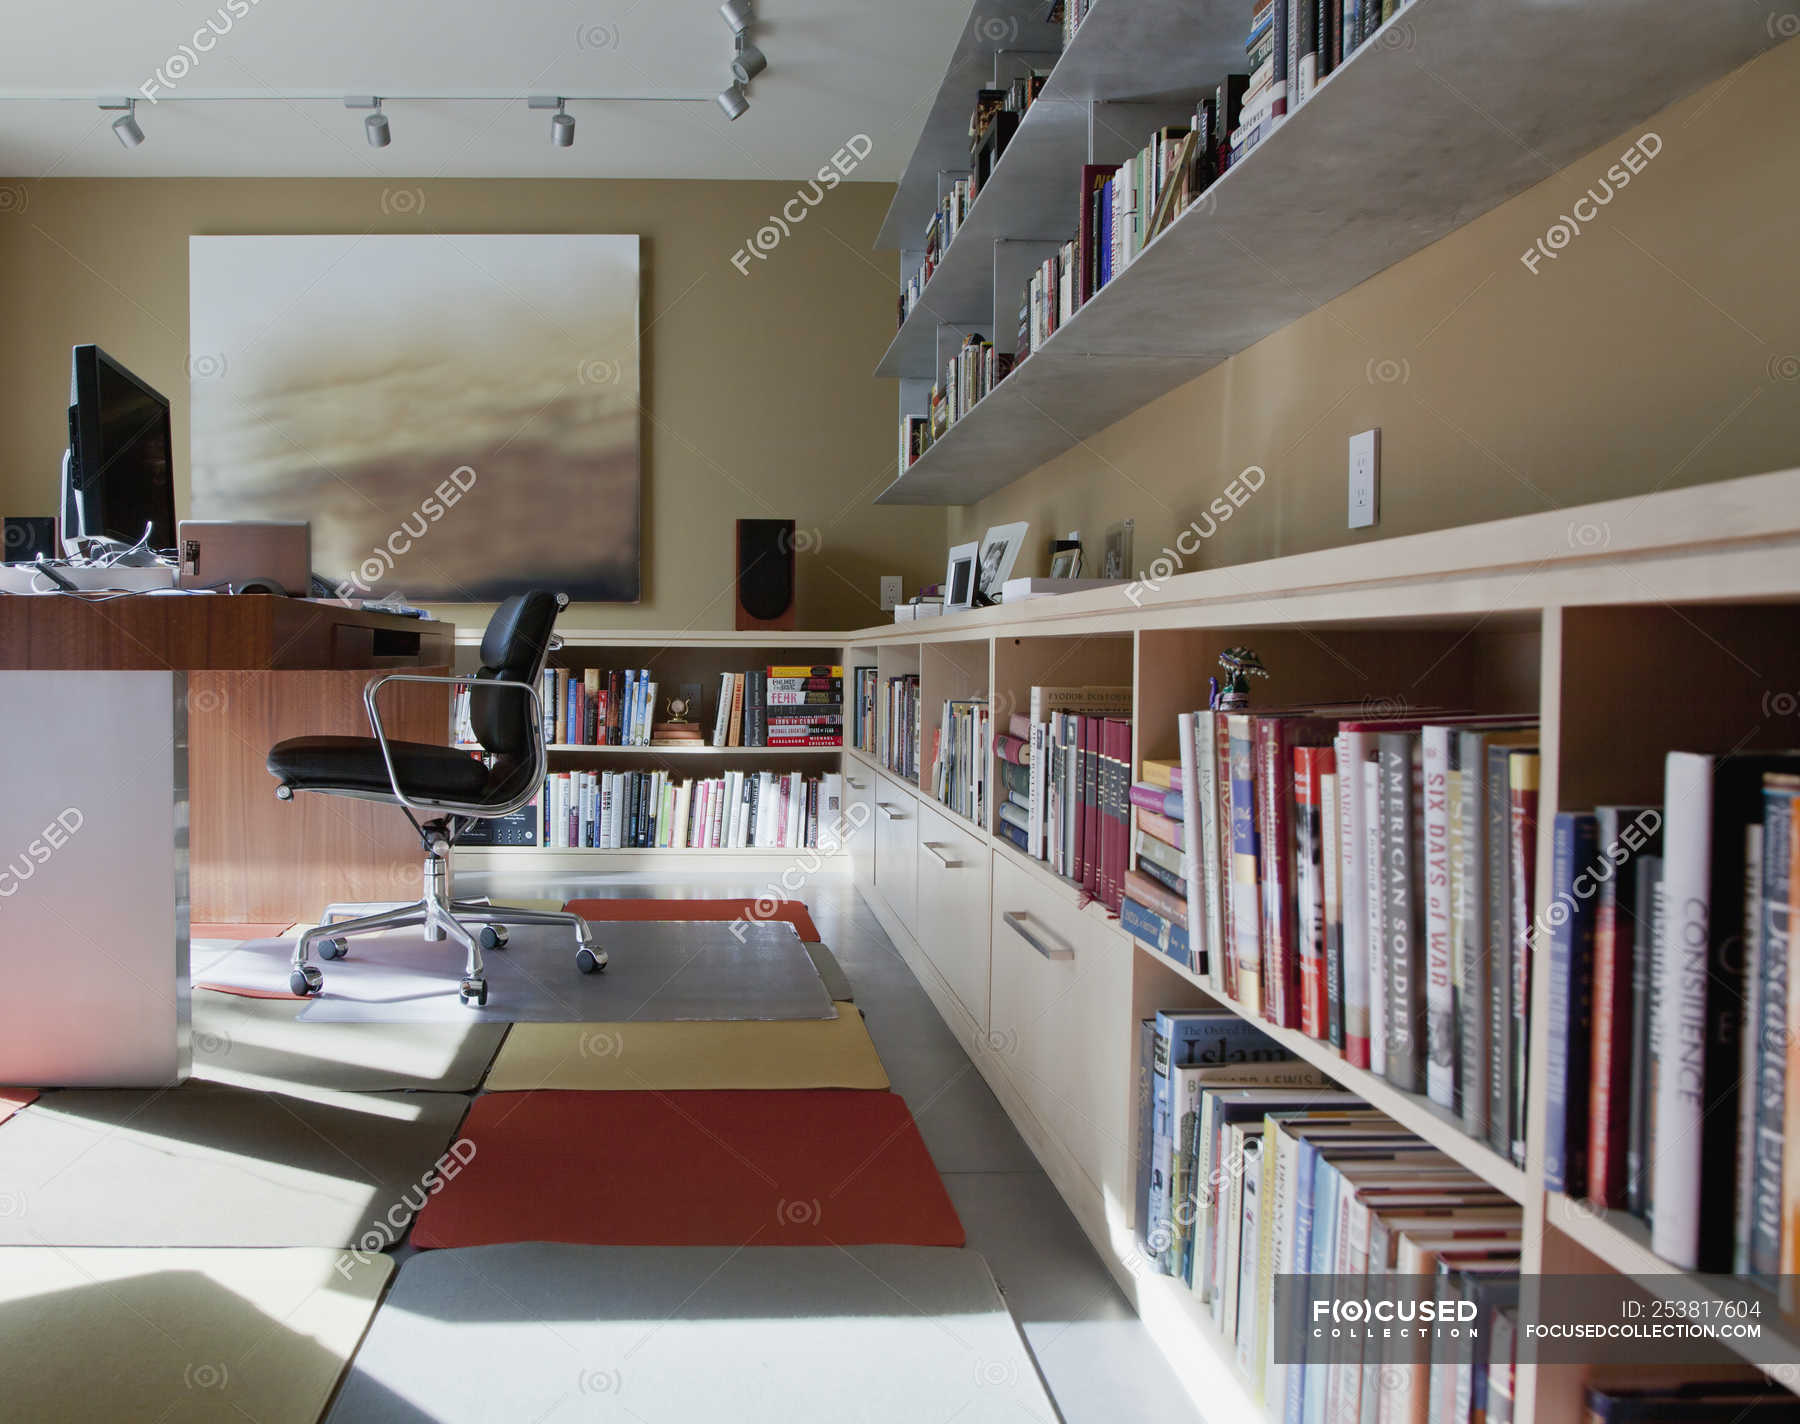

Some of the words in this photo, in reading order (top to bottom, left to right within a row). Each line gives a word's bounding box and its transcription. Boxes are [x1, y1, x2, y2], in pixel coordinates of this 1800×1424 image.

[1389, 751, 1405, 907] AMERICAN
[1427, 773, 1446, 812] SIX
[1428, 823, 1447, 887] DAYS
[1393, 917, 1409, 1044] SOLDIER
[1431, 931, 1449, 988] WAR
[1676, 897, 1710, 1108] CONSILIENCE
[1183, 1037, 1287, 1064] Islam
[1758, 1126, 1785, 1247] Error
